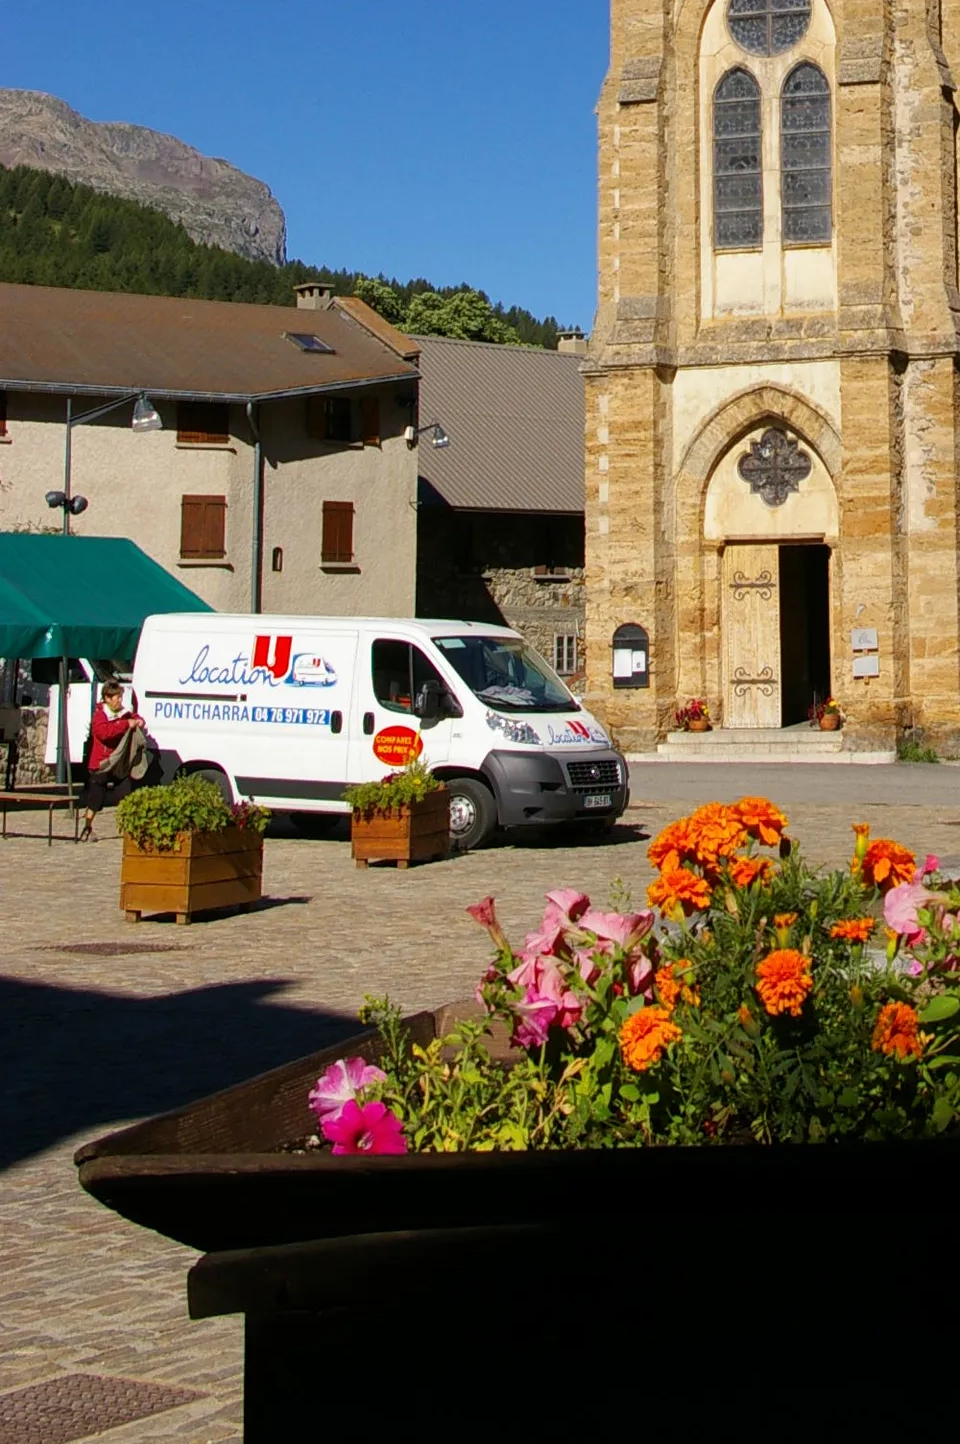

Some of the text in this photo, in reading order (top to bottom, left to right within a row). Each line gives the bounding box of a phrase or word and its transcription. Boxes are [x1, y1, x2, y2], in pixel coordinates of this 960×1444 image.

[179, 635, 293, 687] location U
[154, 702, 326, 725] PONTCHARRA 04 76 971 972
